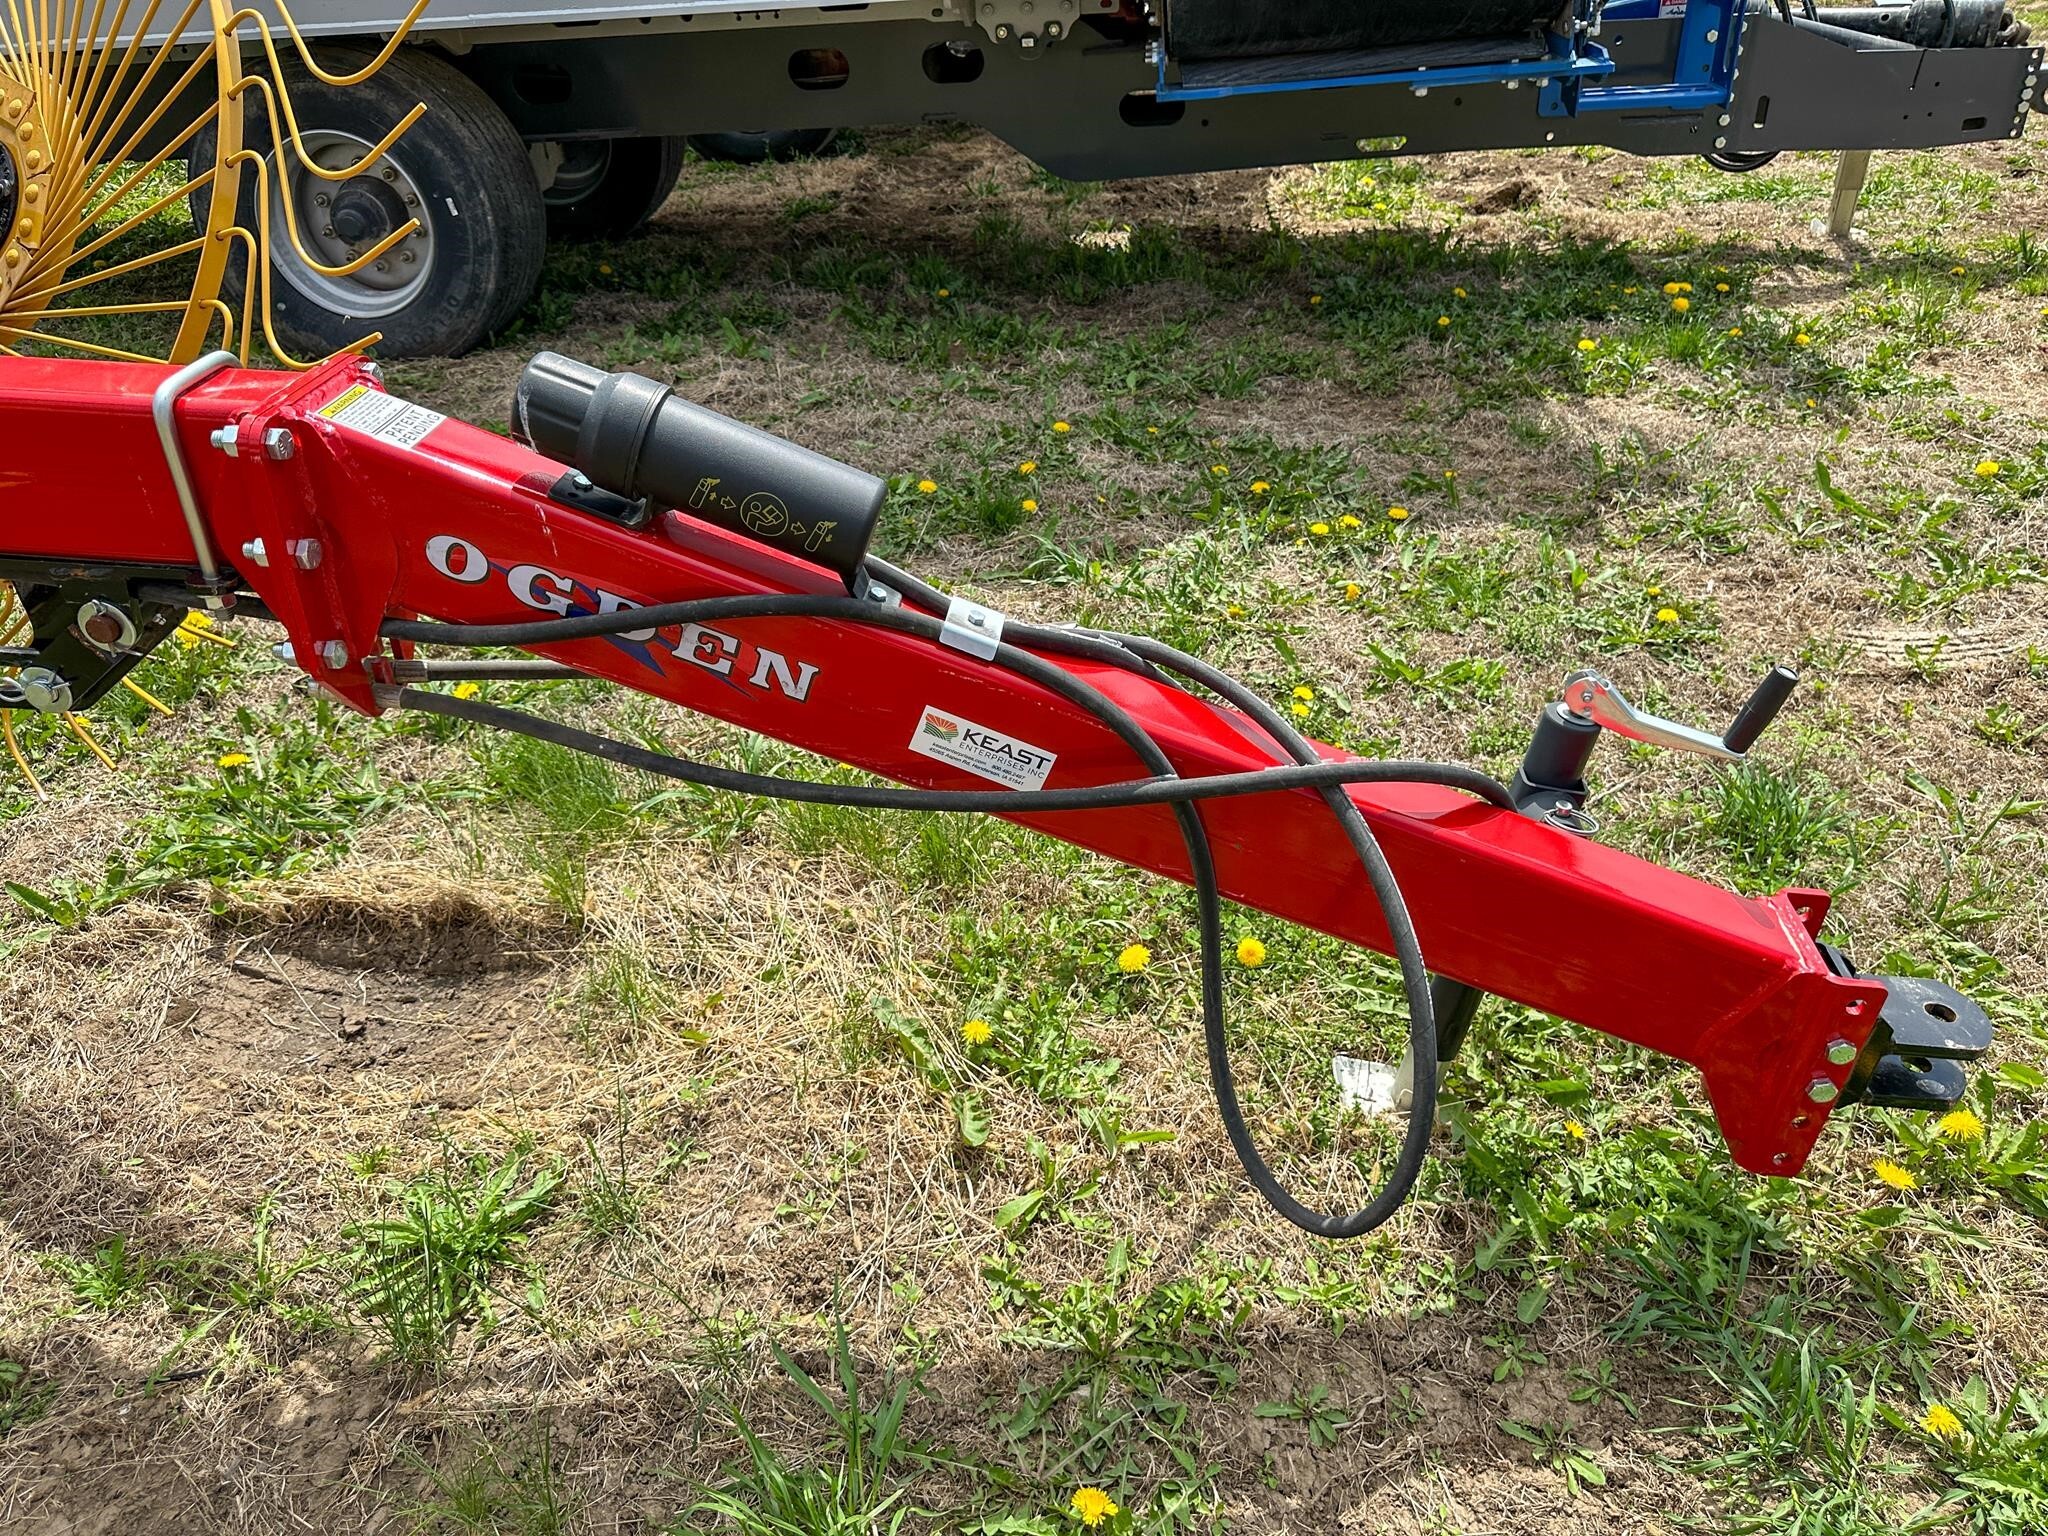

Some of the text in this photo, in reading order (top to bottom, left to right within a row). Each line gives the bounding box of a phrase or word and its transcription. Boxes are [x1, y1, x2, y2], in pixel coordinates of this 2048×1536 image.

[385, 409, 423, 438] PATENT
[397, 412, 441, 446] PENDING
[958, 741, 1046, 779] ENTERPRISES INC
[962, 728, 1052, 770] KEAST
